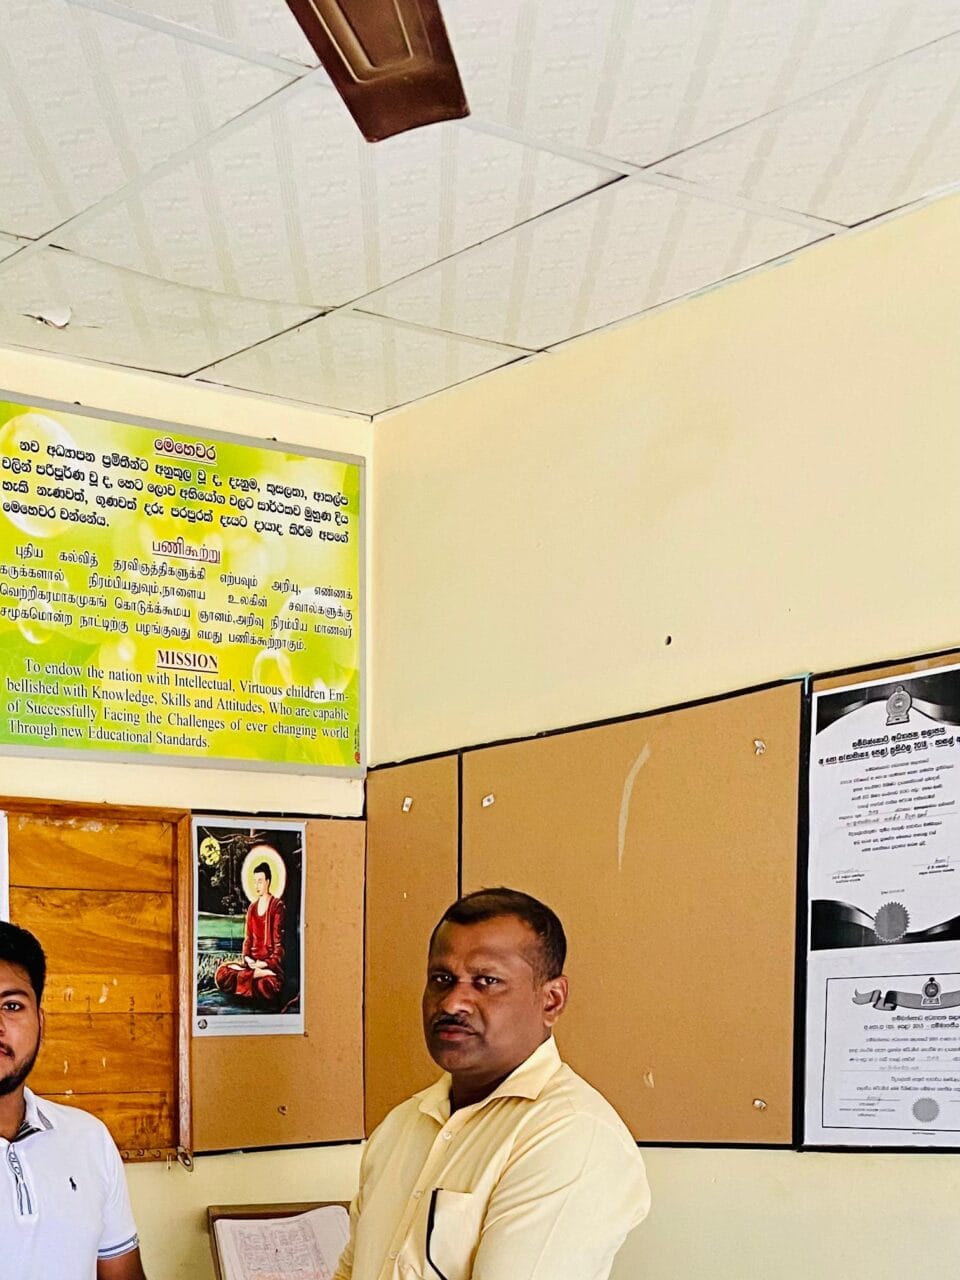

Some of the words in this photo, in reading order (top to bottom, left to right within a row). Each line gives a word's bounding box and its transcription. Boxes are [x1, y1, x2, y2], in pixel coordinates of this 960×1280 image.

[20, 441, 40, 452] නව
[47, 445, 96, 463] අධ්‍යාපන
[154, 438, 216, 460] මෙහෙවර
[2, 457, 31, 473] වලින්
[118, 478, 143, 490] හෙට
[148, 483, 176, 497] ලොව
[3, 501, 56, 519] මෙහෙවර
[96, 495, 137, 510] ගුණවත්
[144, 503, 164, 515] දරු
[171, 506, 213, 523] පරපුරක්
[16, 543, 43, 559] புதிய
[59, 550, 98, 567] கல்வித்
[0, 564, 64, 581] கருக்களால்
[228, 593, 267, 607] உலகின்
[289, 601, 352, 620] சவால்களுக்கு
[80, 614, 128, 633] நாட்டிற்கு
[198, 629, 222, 643] எமது
[271, 616, 307, 631] நிரம்பிய
[314, 622, 352, 638] மாணவர்
[157, 650, 218, 669] MISSION
[25, 659, 40, 672] To
[45, 662, 82, 676] endow
[87, 665, 104, 678] the
[109, 668, 142, 683] nation
[147, 672, 170, 686] with
[175, 674, 235, 692] Intellectual,
[240, 680, 282, 696] Virtuous
[286, 685, 325, 700] children
[329, 688, 348, 701] Em-
[7, 678, 59, 695] bellished
[64, 684, 87, 698] with
[161, 692, 191, 707] Skills
[195, 698, 212, 709] and
[270, 701, 292, 715] Who
[296, 707, 310, 717] are
[313, 707, 348, 722] capable
[8, 700, 21, 713] of
[26, 700, 97, 722] Successfully
[104, 707, 140, 725] Facing
[146, 710, 162, 724] the
[167, 712, 225, 731] Challenges
[230, 718, 242, 731] of
[246, 722, 268, 732] ever
[272, 722, 317, 739] changing
[322, 726, 348, 738] world
[9, 719, 57, 739] Through
[61, 727, 83, 738] new
[89, 725, 152, 743] Educational
[156, 731, 210, 749] Standards.
